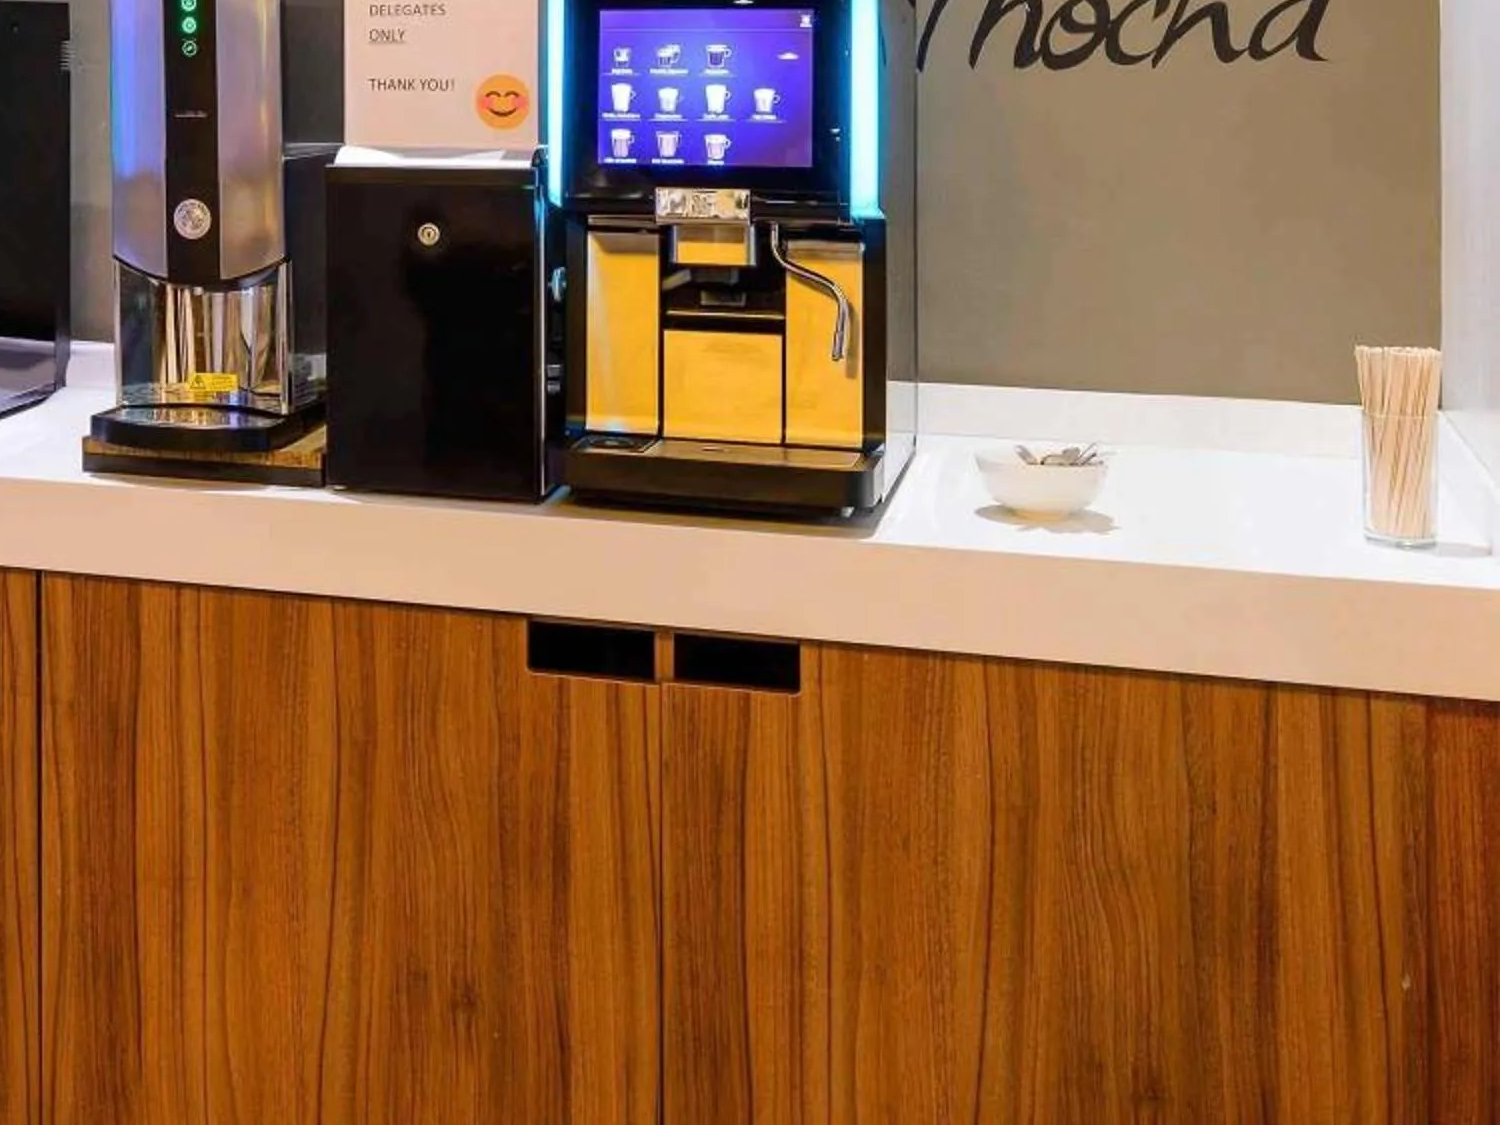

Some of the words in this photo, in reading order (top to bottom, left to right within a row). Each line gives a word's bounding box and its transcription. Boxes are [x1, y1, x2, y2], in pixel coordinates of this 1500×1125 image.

[369, 3, 447, 17] DELEGATES
[368, 29, 406, 44] ONLY
[369, 78, 416, 92] THANK
[419, 78, 455, 92] YOU!
